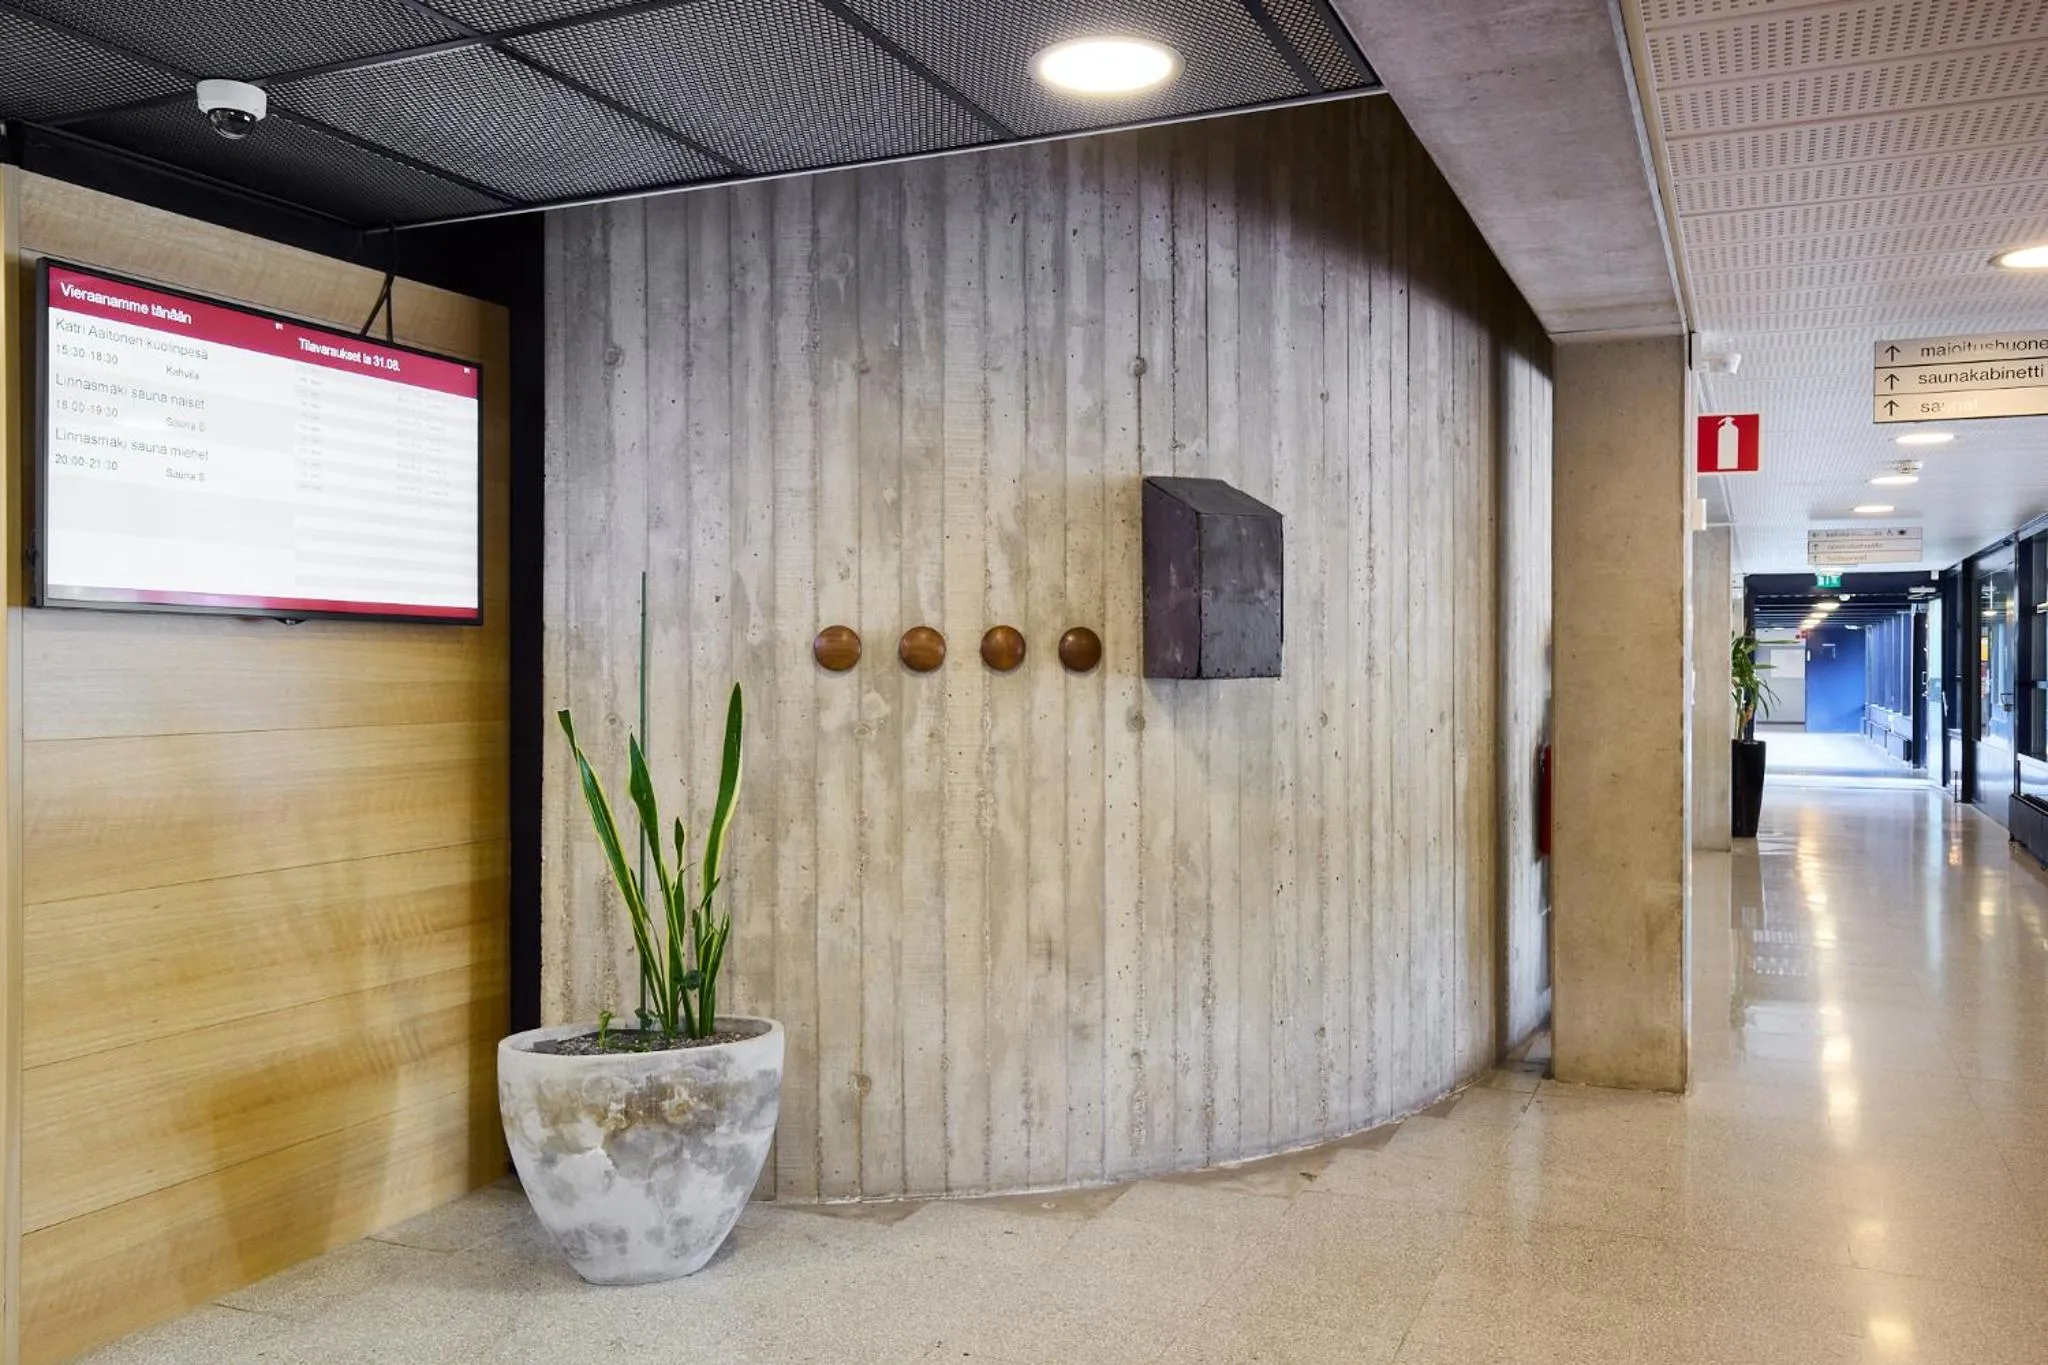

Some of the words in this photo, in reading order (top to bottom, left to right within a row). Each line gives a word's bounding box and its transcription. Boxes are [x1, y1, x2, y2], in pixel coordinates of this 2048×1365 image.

[60, 282, 149, 314] Vieraanamme
[150, 303, 192, 324] tänään
[56, 318, 86, 334] Katri
[88, 324, 143, 345] Aaltonen
[298, 337, 362, 363] Tilavaraukset
[1918, 364, 2044, 385] saunakabinetti
[131, 387, 168, 403] sauna
[170, 395, 205, 410] naiset
[131, 440, 168, 455] sauna
